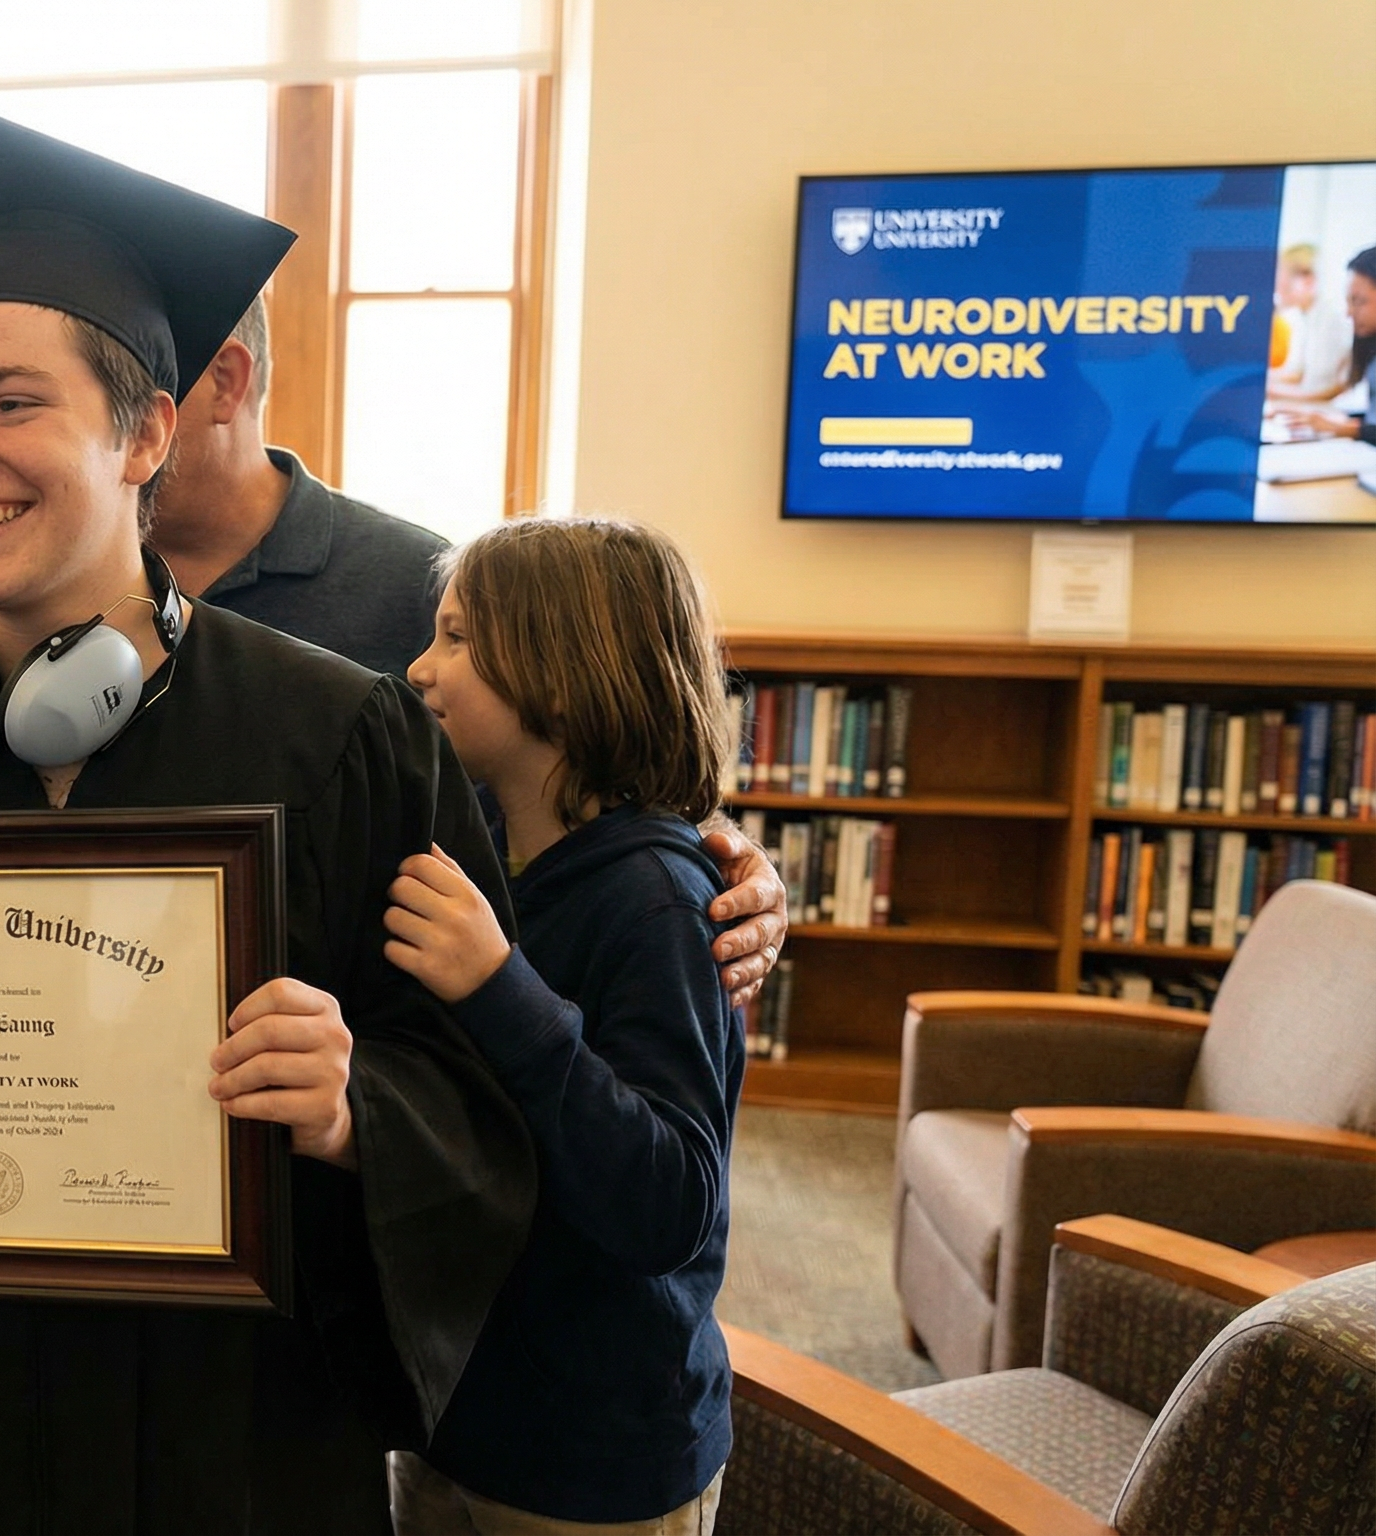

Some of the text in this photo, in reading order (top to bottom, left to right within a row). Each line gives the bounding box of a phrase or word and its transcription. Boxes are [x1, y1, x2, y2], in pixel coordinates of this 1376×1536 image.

[828, 296, 1249, 335] NEURODIVERSITY
[824, 342, 1047, 379] AT WORK
[17, 1077, 34, 1087] AT
[37, 1077, 79, 1088] WORK
